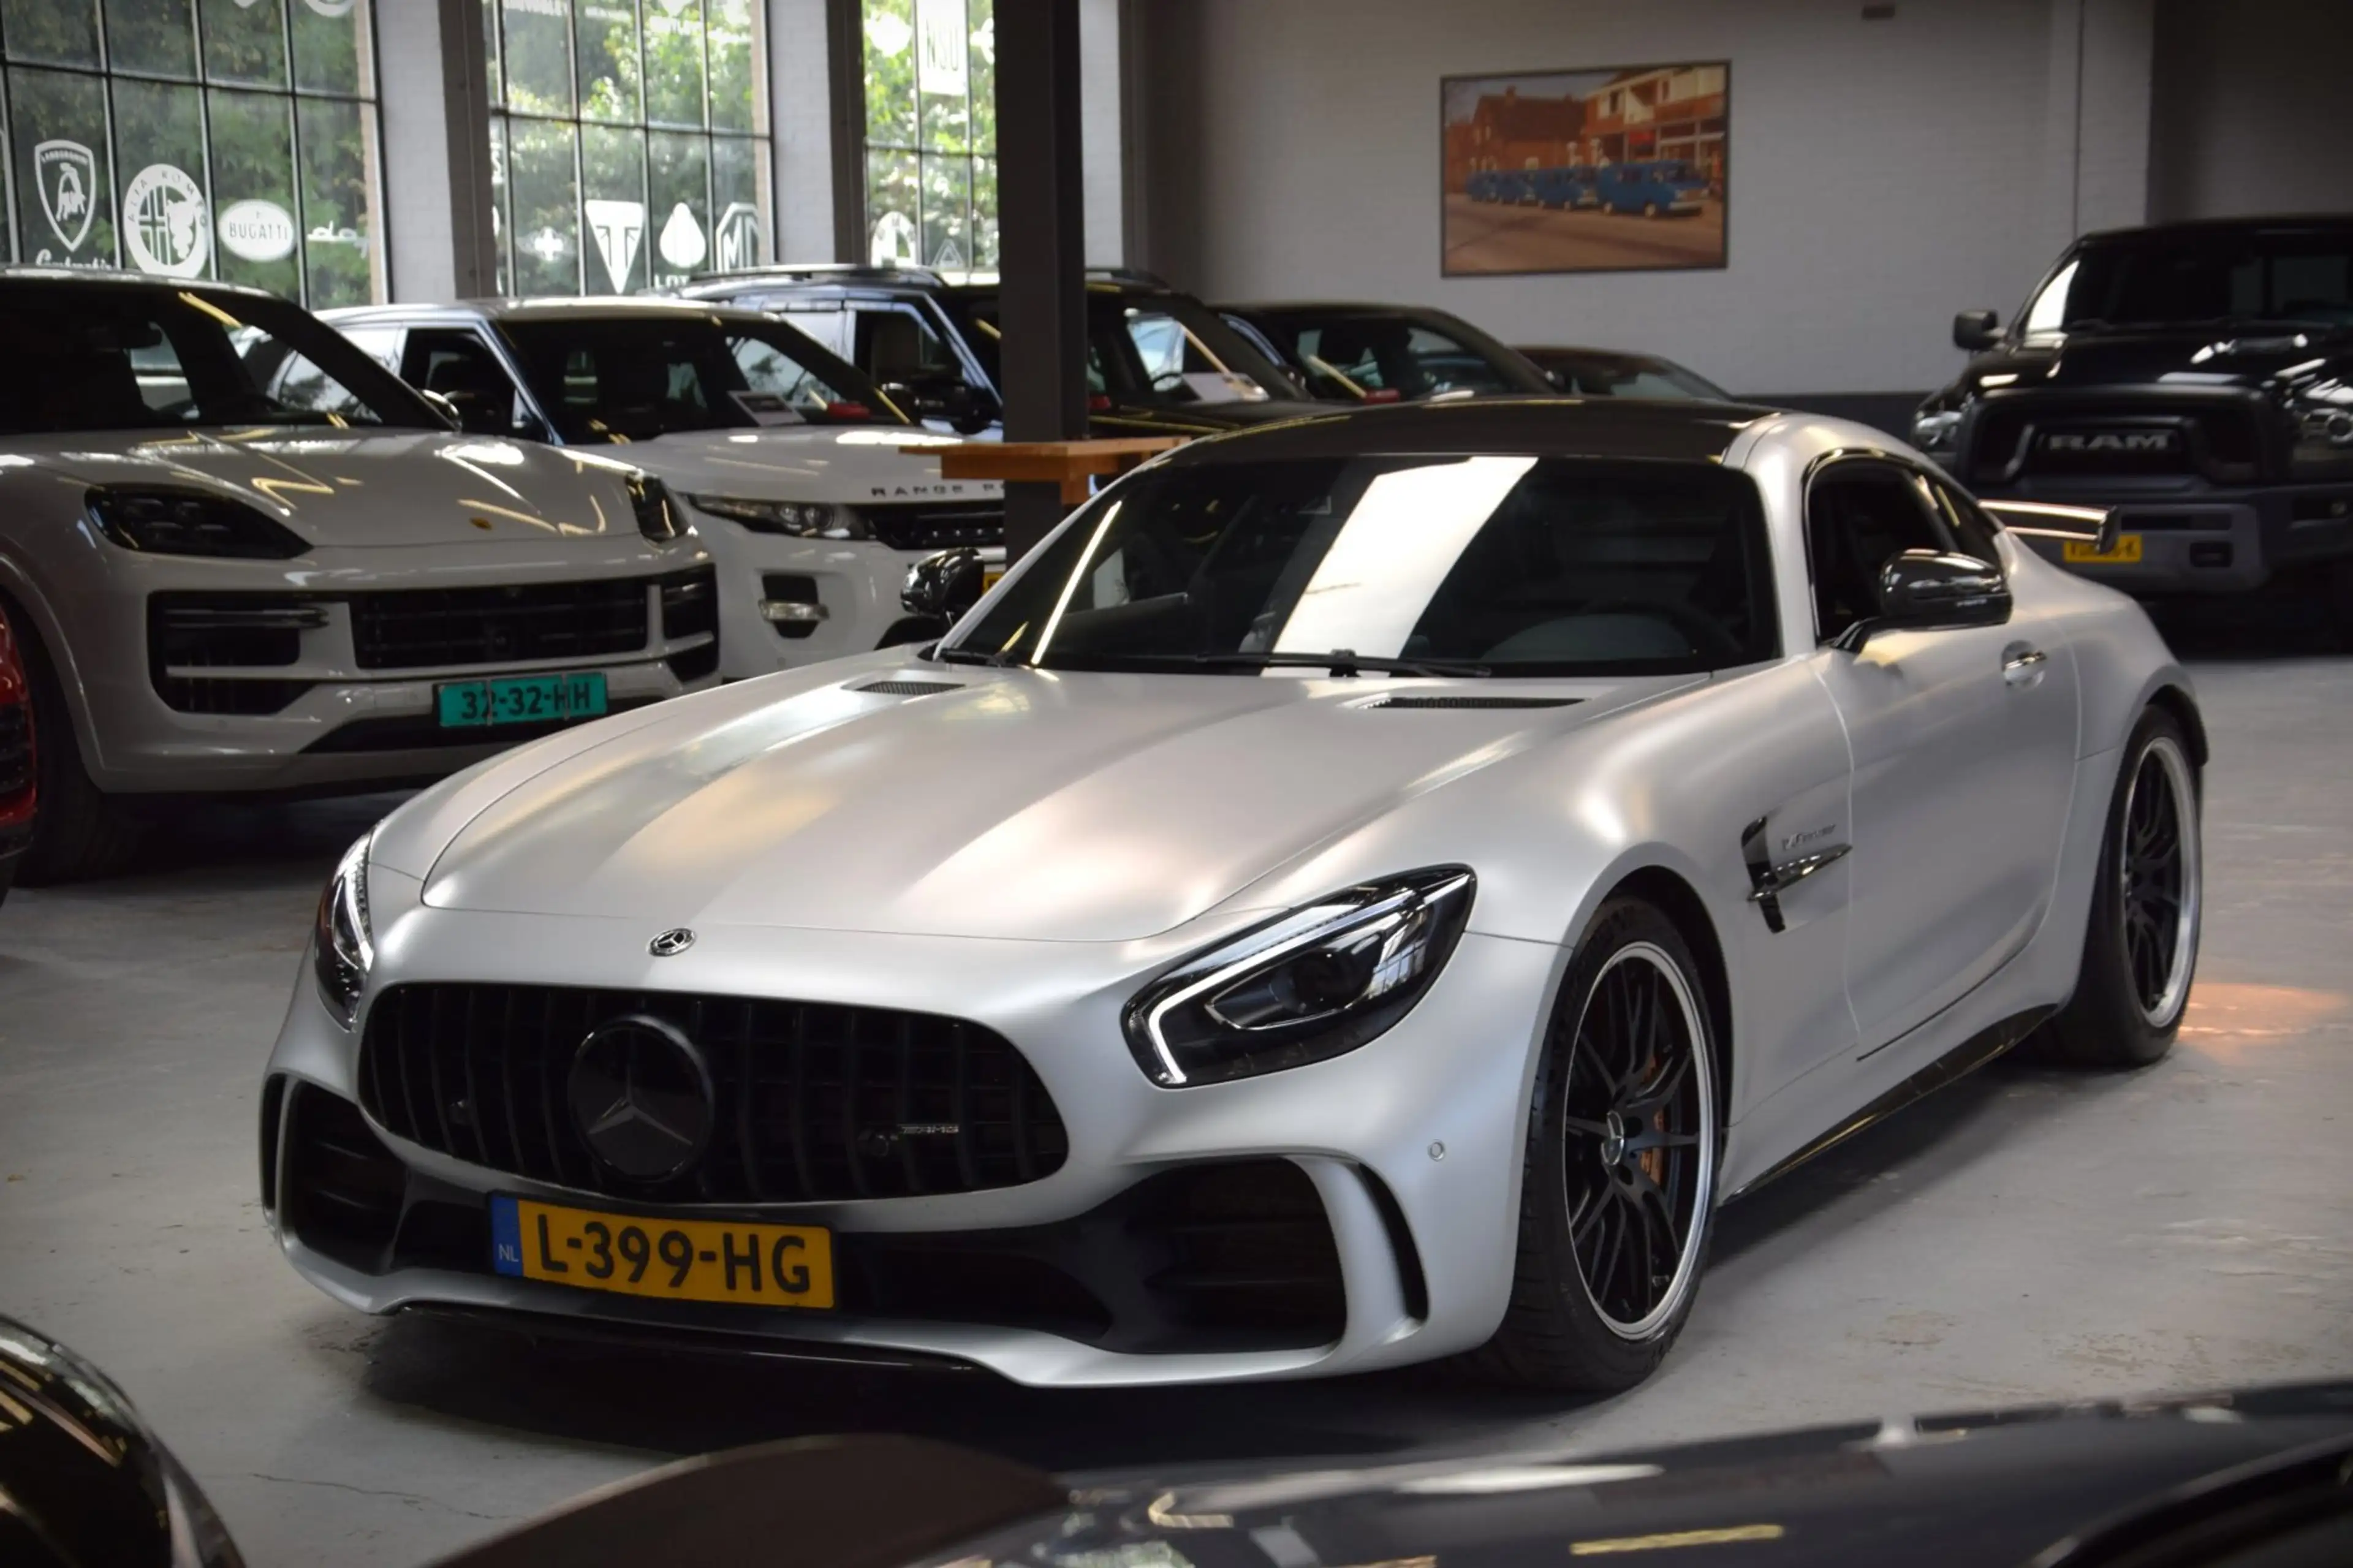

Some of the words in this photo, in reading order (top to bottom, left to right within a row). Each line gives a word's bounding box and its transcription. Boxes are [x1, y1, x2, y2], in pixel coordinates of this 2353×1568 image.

[229, 221, 287, 240] BUGATTI
[2049, 434, 2168, 450] RAM
[871, 485, 963, 496] RANGE
[461, 681, 591, 720] 32-32-HH
[498, 1243, 519, 1263] NL
[537, 1213, 811, 1293] L-399-HG
